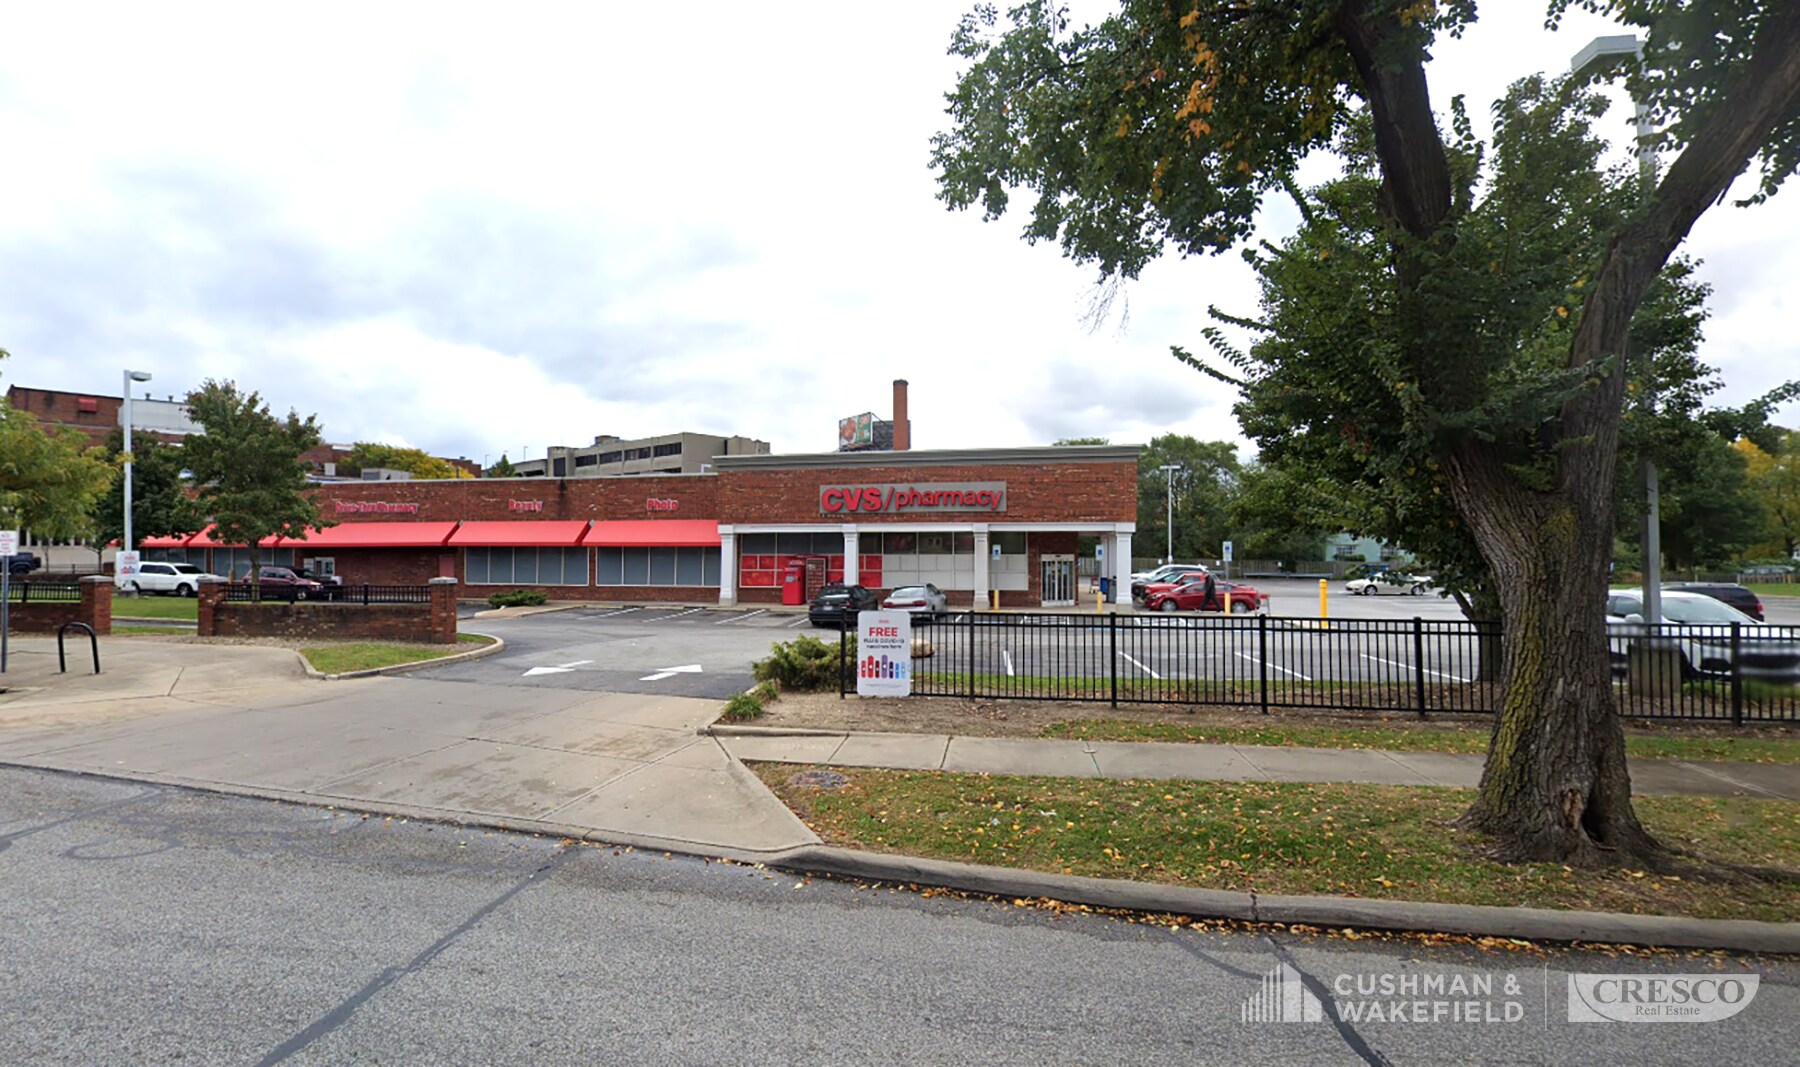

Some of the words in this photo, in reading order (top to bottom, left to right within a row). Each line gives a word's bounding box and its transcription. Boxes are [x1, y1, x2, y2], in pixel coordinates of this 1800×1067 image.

[377, 501, 418, 515] Pharmacy
[508, 499, 543, 512] Beauty
[647, 498, 679, 511] Photo
[869, 627, 898, 637] FREE
